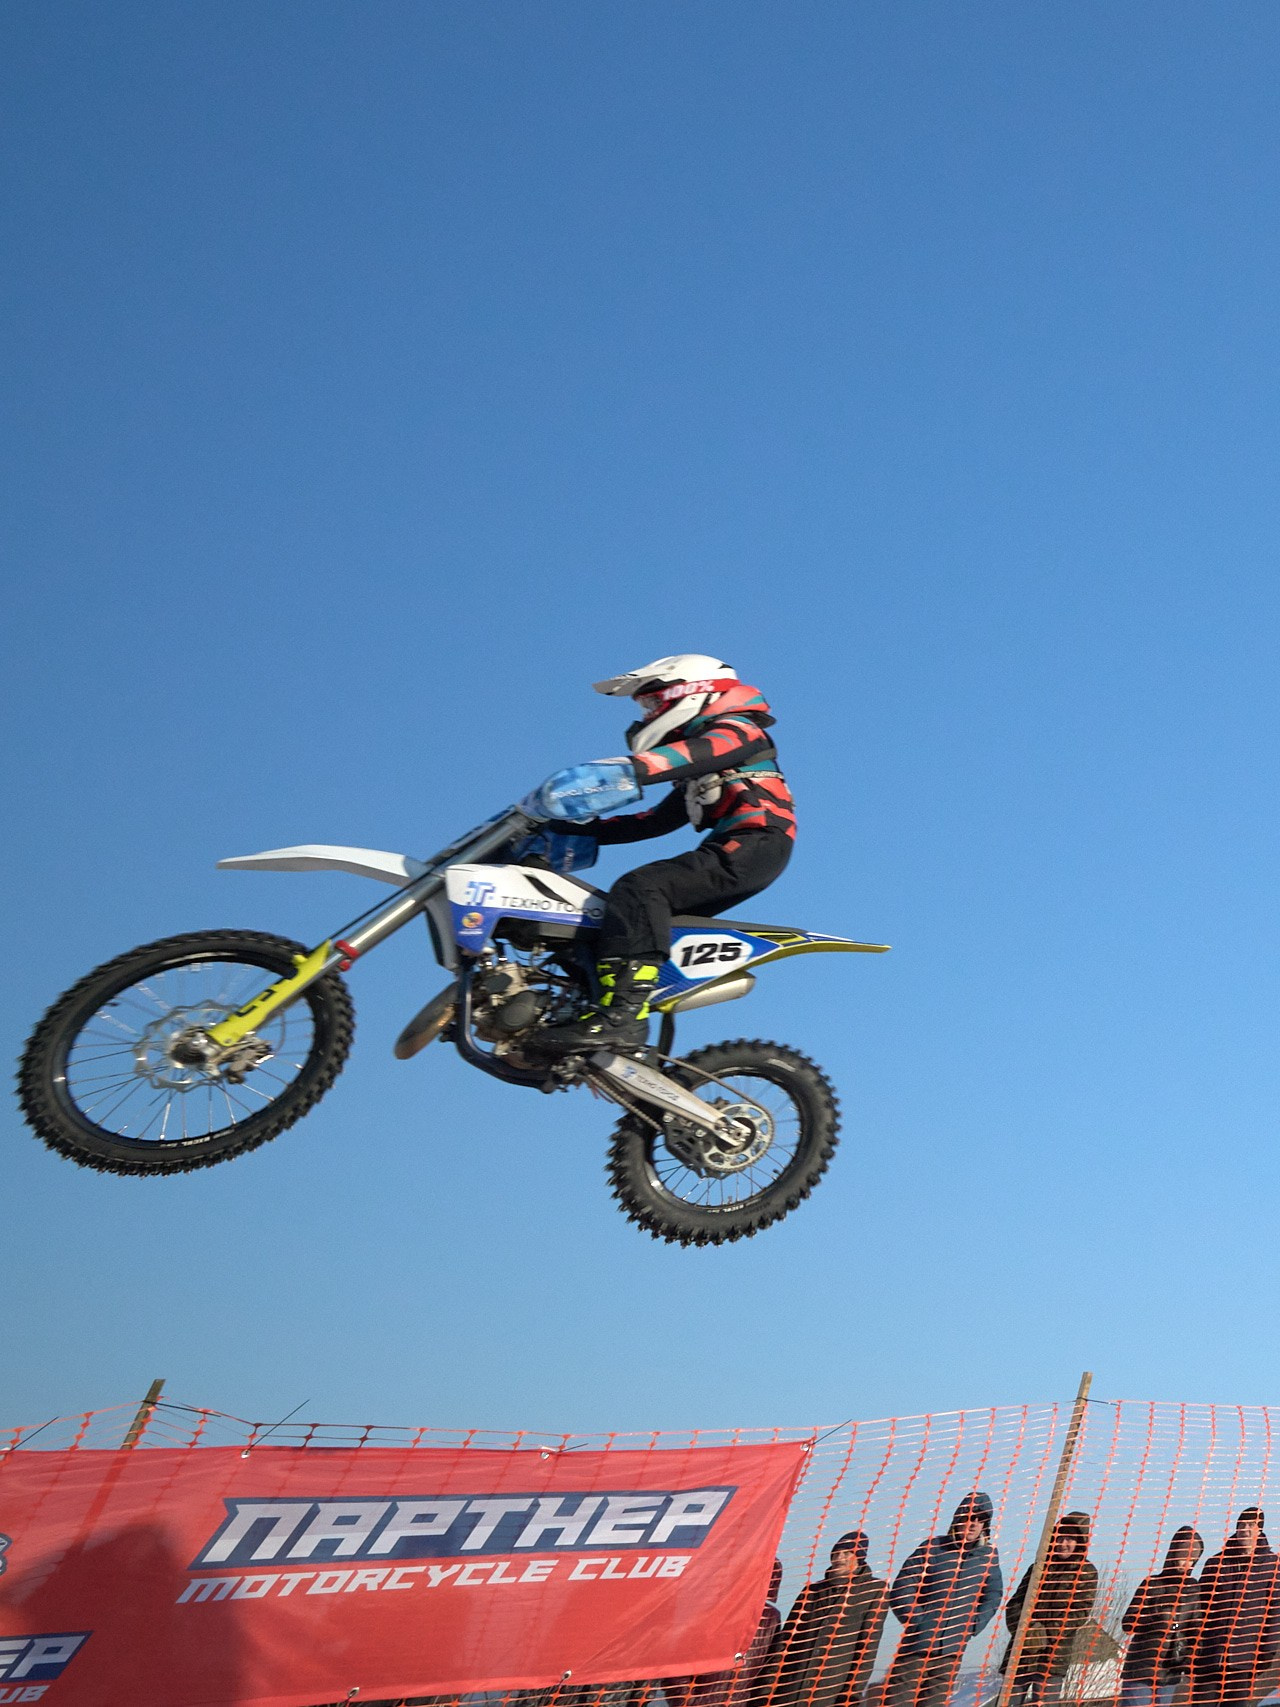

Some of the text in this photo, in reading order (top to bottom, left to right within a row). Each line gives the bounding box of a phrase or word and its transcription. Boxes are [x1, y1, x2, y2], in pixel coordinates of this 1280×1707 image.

[662, 680, 715, 700] 100%
[680, 942, 742, 967] 125
[201, 1490, 731, 1563] ПАРТНЕР
[175, 1555, 693, 1605] MOTORCYCLE CLUB
